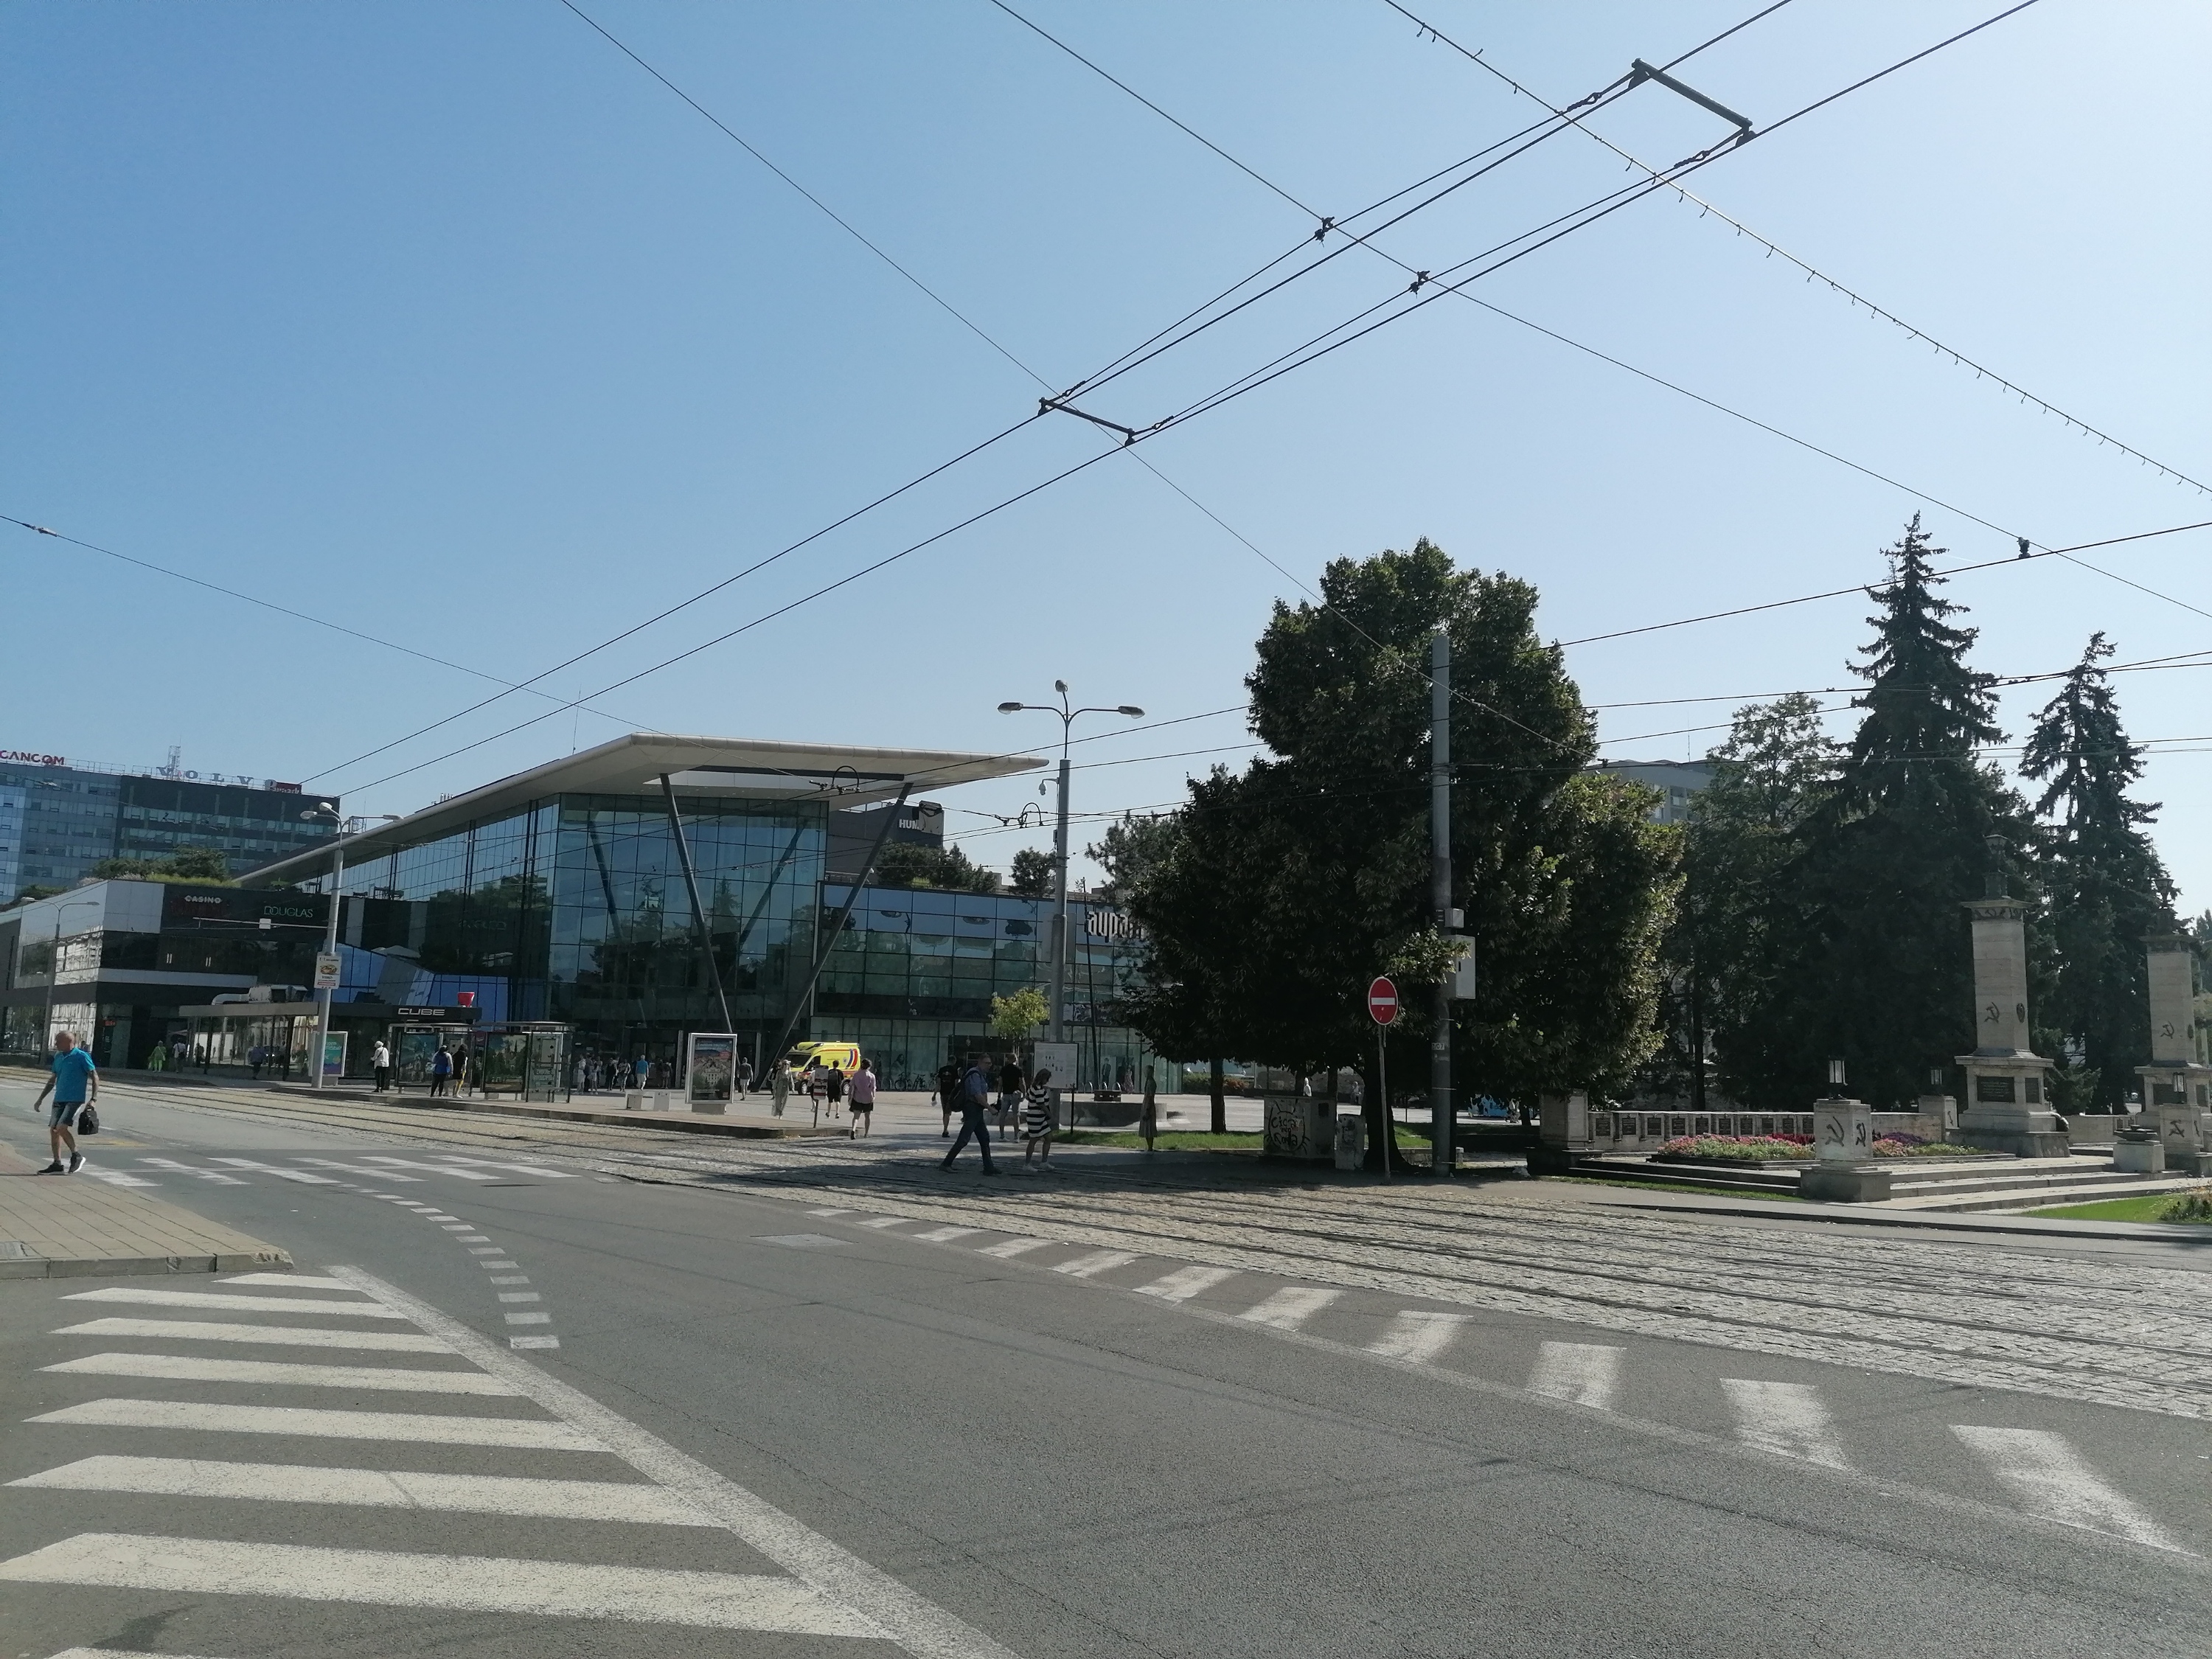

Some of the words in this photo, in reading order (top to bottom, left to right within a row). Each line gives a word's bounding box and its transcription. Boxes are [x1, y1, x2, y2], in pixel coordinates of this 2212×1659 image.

[0, 750, 65, 765] CANCOM
[184, 895, 222, 903] CASINO
[264, 906, 313, 918] DOUGLAS
[398, 1008, 445, 1016] CUBE
